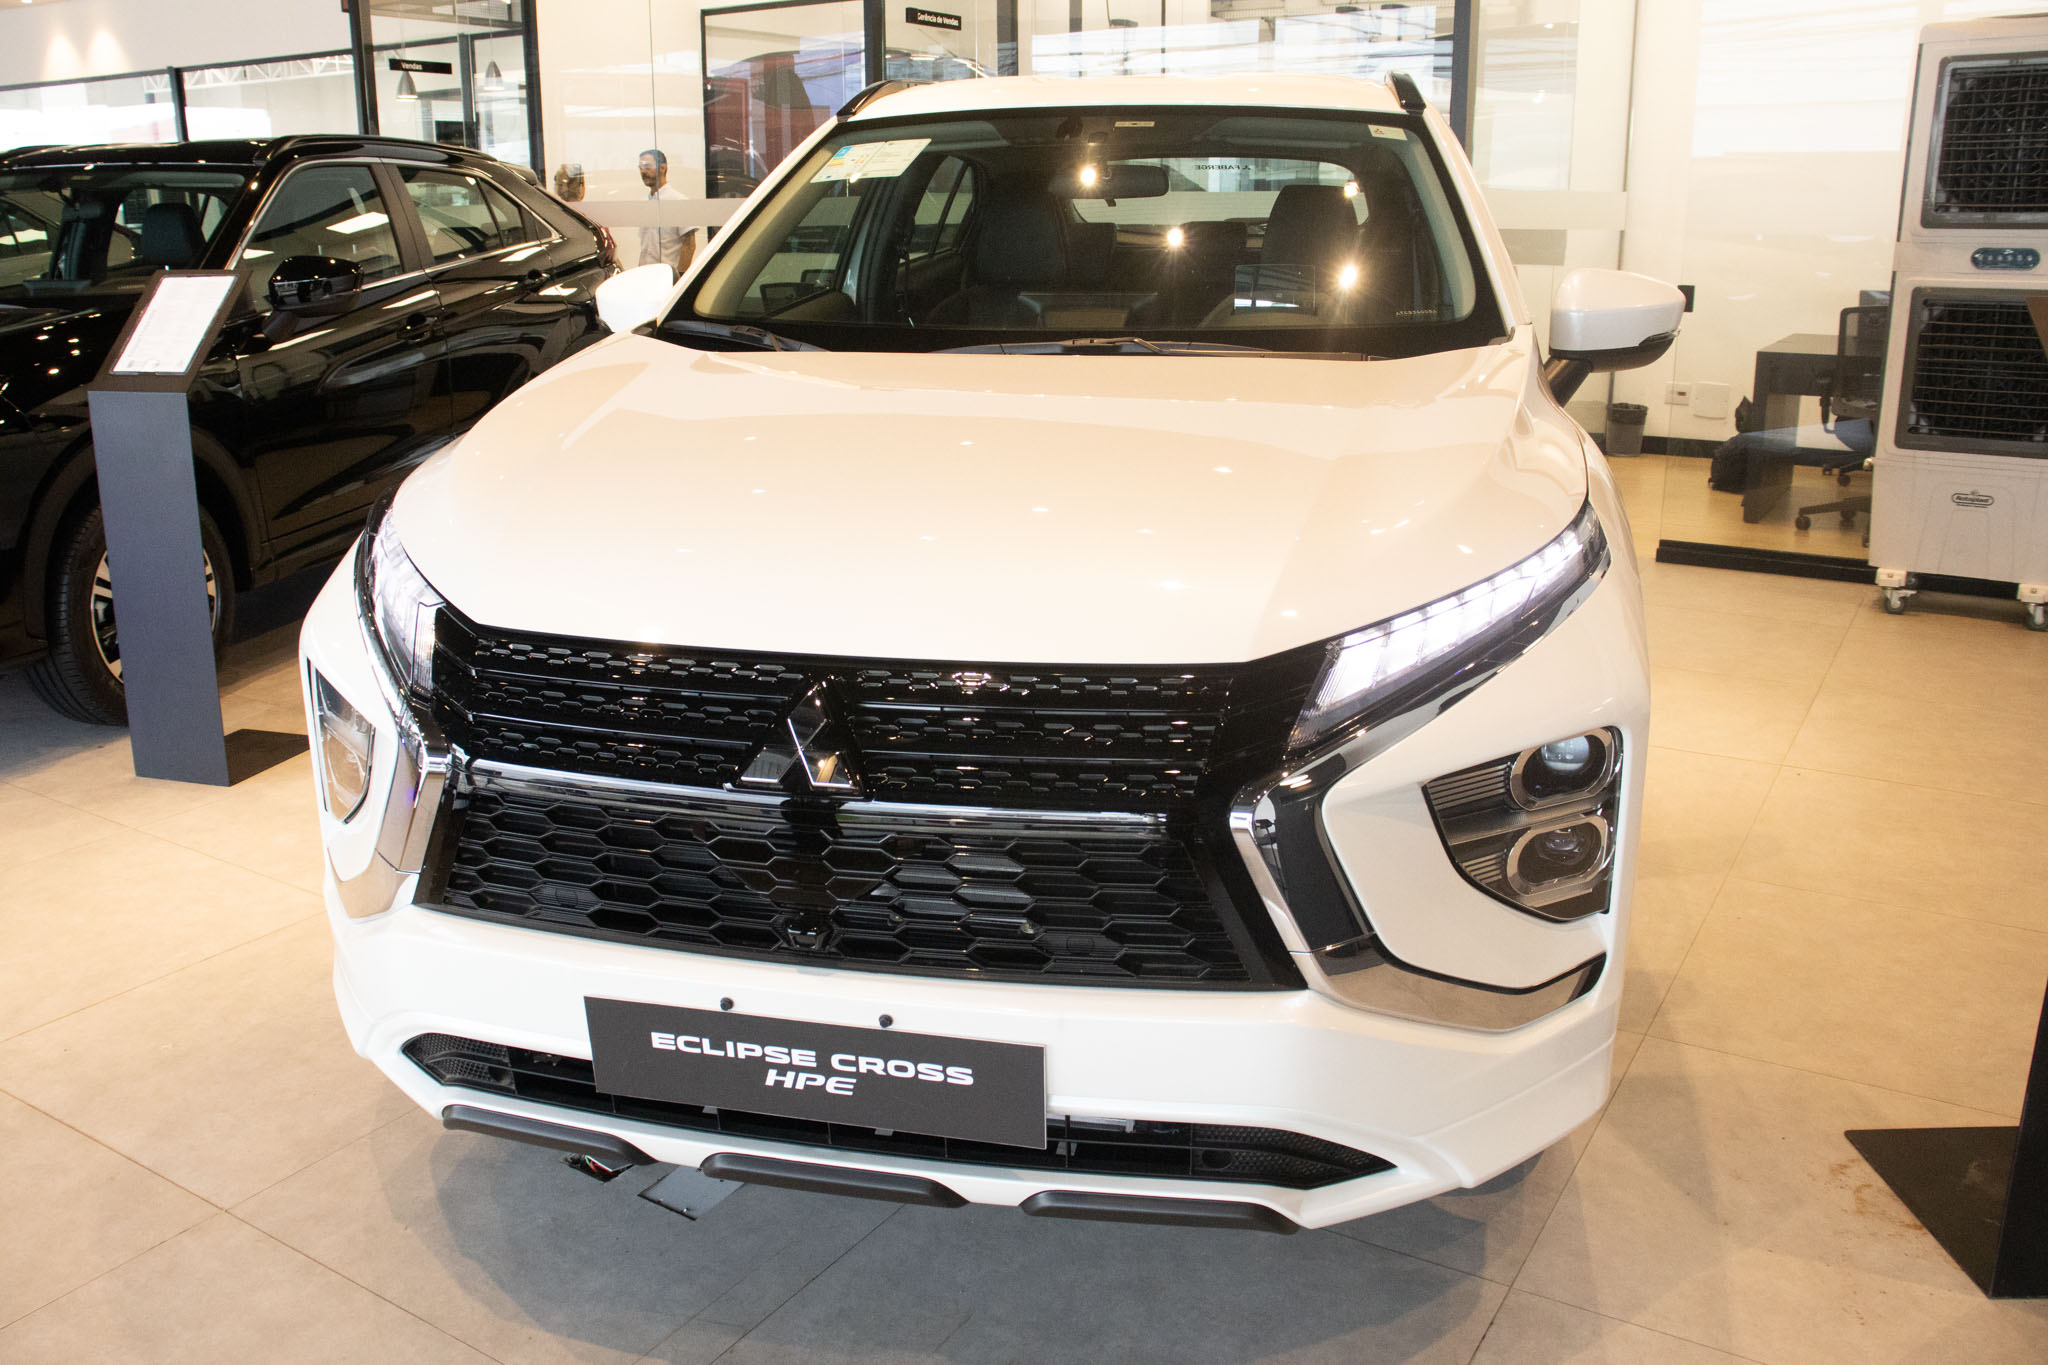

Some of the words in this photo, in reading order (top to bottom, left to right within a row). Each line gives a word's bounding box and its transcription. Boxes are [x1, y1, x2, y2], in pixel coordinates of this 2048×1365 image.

[943, 17, 959, 26] Vendas
[401, 61, 422, 70] Vendas
[651, 1031, 816, 1067] ECLIPSE
[830, 1053, 974, 1085] CROSS
[765, 1069, 857, 1096] HPE
